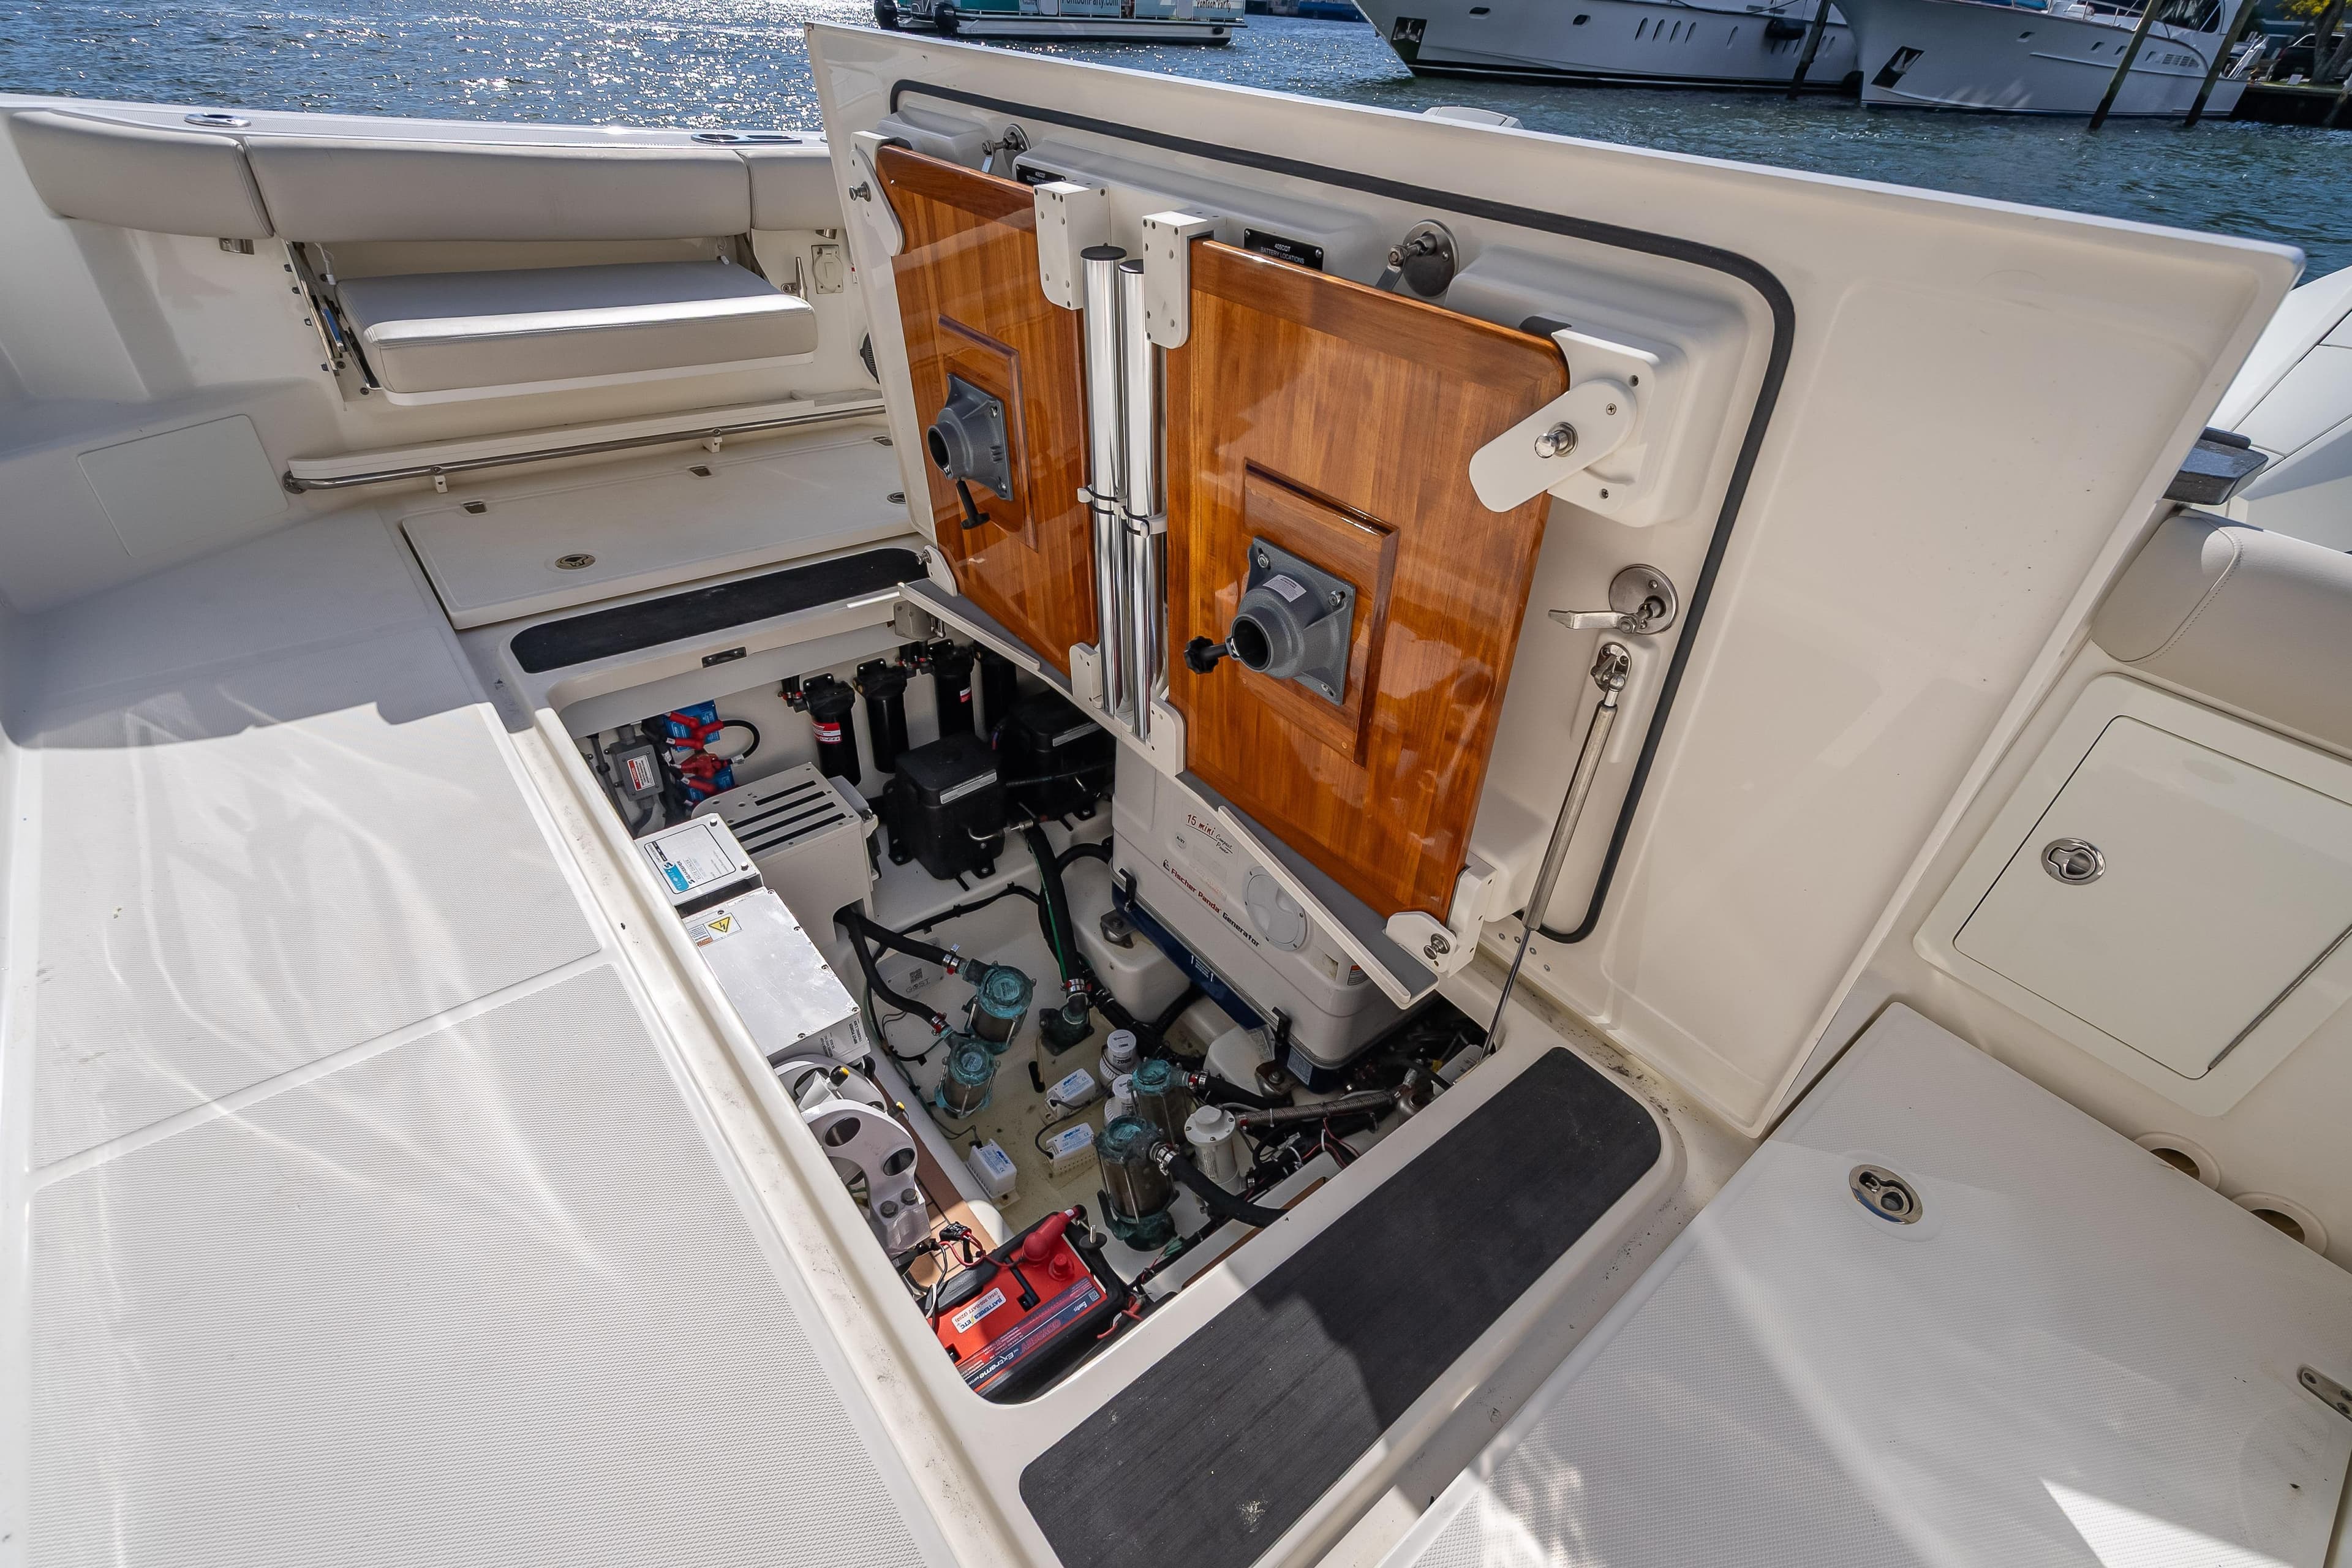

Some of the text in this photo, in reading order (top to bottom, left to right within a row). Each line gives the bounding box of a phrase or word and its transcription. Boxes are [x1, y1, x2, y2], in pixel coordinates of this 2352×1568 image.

[1218, 0, 1231, 12] Party
[1261, 247, 1305, 264] BATTERY LOCATIONS
[1186, 813, 1233, 850] 15 mini Compact
[1216, 842, 1229, 854] Power
[1171, 868, 1197, 894] Fischer
[1223, 912, 1261, 948] Generator
[960, 1297, 1002, 1329] BATTERIES ETC
[976, 1349, 1015, 1379] Extreme
